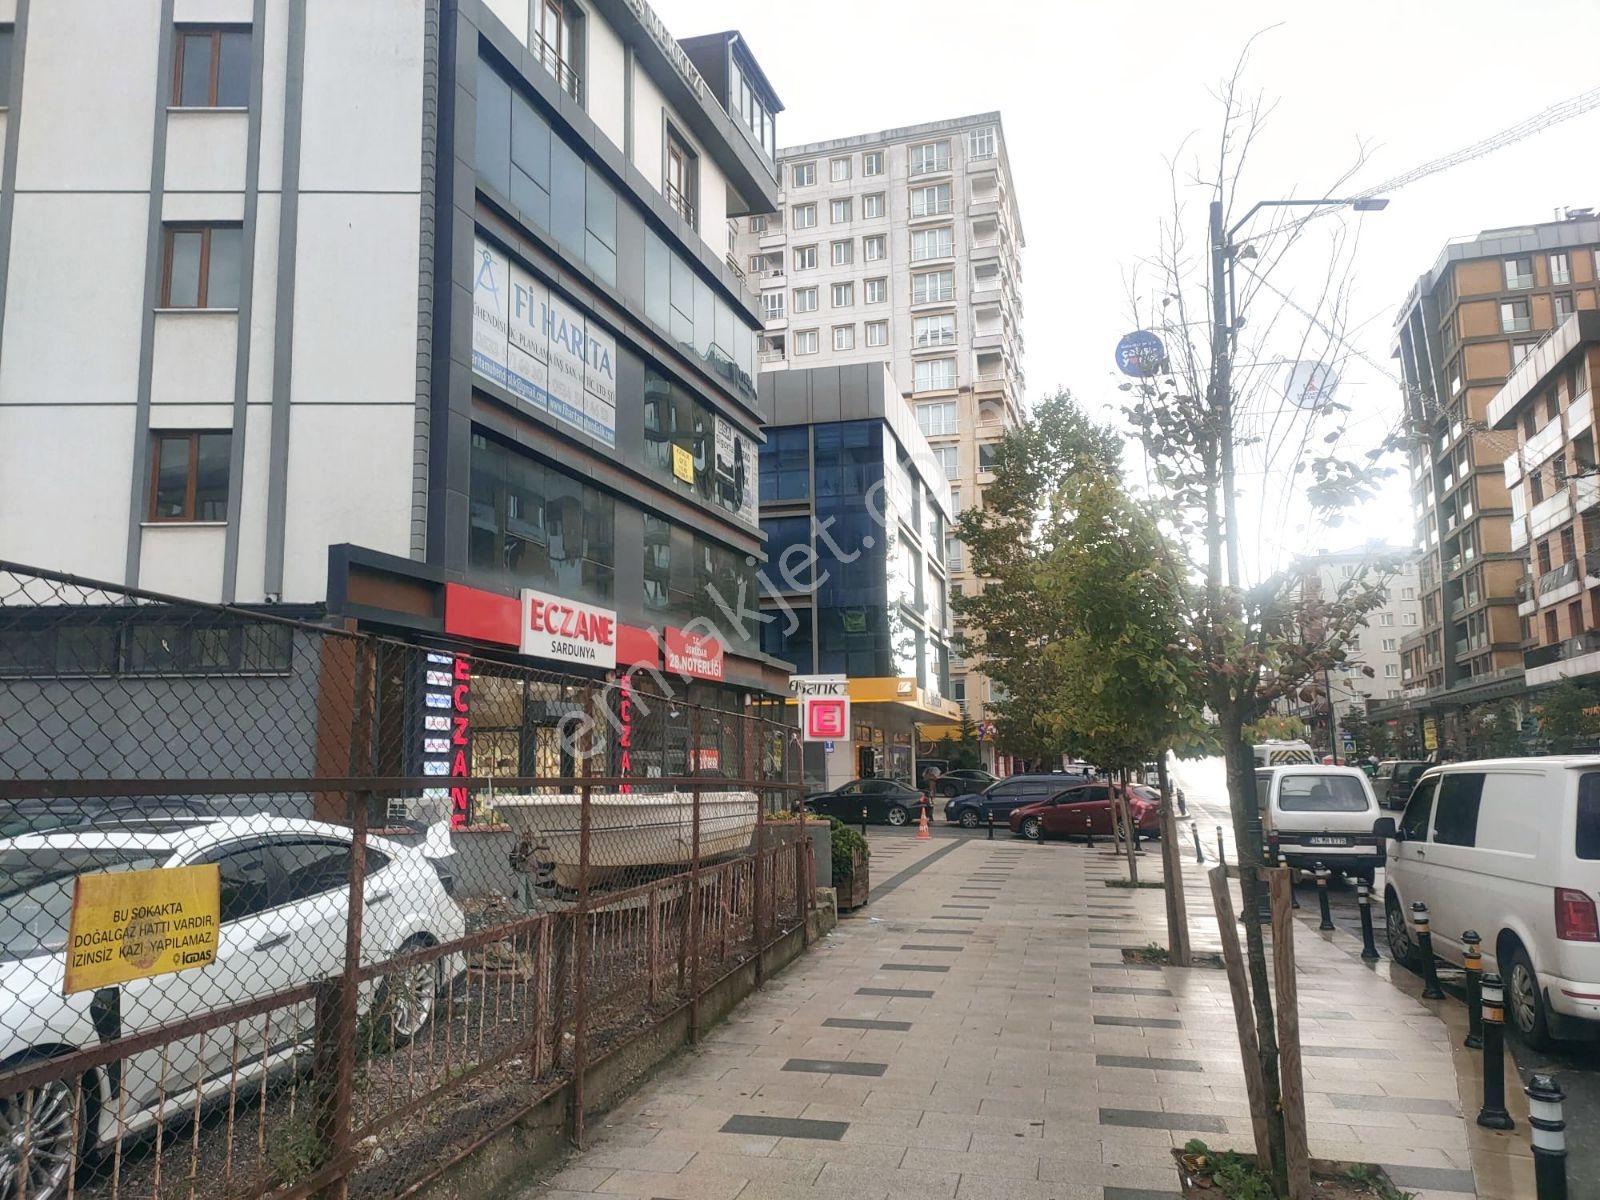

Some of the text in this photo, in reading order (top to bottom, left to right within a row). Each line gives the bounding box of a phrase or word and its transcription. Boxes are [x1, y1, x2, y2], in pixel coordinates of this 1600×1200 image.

[541, 301, 613, 381] HARİTA
[530, 598, 614, 647] ECZANE
[551, 640, 596, 660] SARDUNYA
[113, 902, 183, 923] BU SOKAKTA
[74, 925, 136, 948] DOĞALGAZ
[139, 921, 170, 937] HATTI
[119, 944, 143, 958] KAZI
